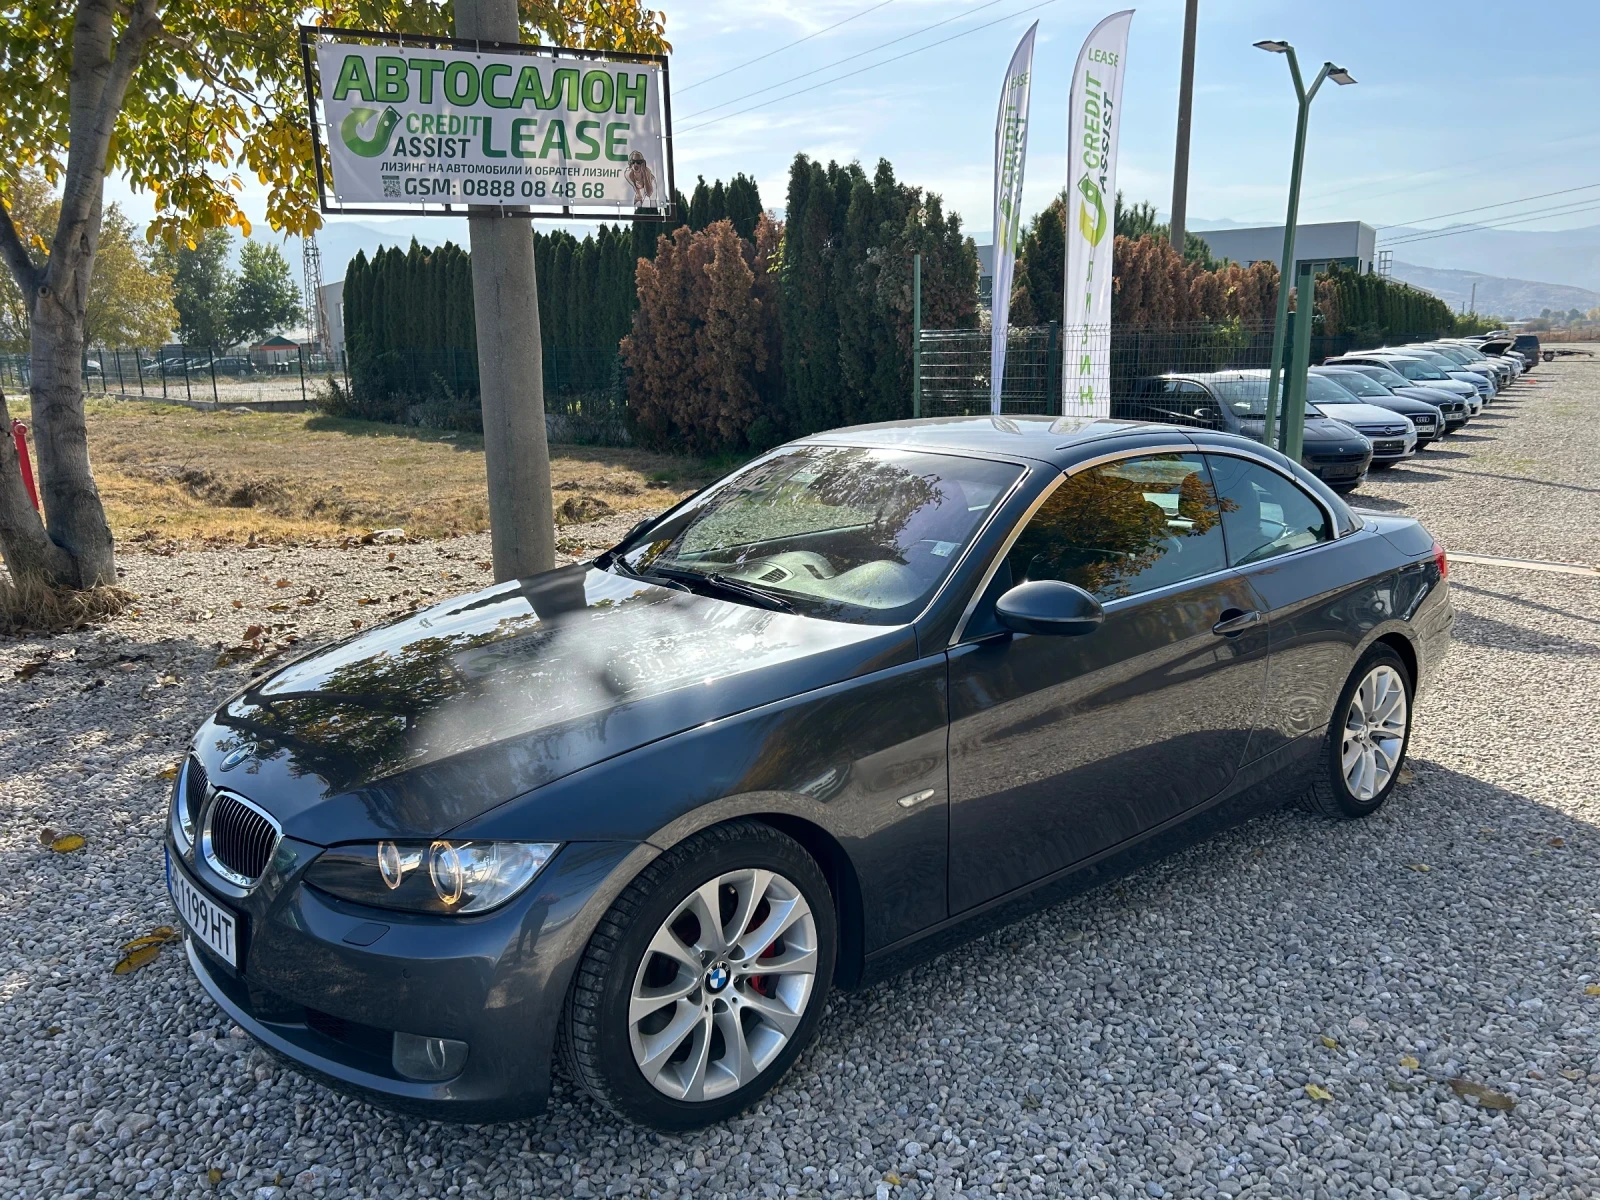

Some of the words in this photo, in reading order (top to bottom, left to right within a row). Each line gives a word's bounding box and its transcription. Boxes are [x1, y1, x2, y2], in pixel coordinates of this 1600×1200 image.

[1088, 47, 1119, 67] LEASE
[333, 55, 648, 115] АВТОСАЛОН
[405, 113, 482, 136] CREDIT
[482, 116, 630, 161] LEASE
[1083, 69, 1102, 170] CREDIT
[1098, 92, 1114, 195] ASSIST
[380, 162, 426, 173] ЛИЗИНГ
[428, 163, 444, 173] НА
[446, 163, 522, 175] АВТОМОБИЛИ
[524, 166, 532, 175] И
[534, 166, 580, 176] ОБРАТЕН
[582, 167, 622, 178] ЛИЗИНГ
[392, 136, 471, 158] ASSIST
[1002, 104, 1016, 188] CREDIT
[404, 177, 456, 196] GSM:
[463, 179, 515, 197] 0888
[520, 180, 546, 198] 08
[551, 181, 577, 198] 48
[581, 182, 605, 199] 68
[1079, 260, 1094, 418] ЛИЗИН
[180, 878, 208, 937] 1199
[210, 906, 232, 956] HT
